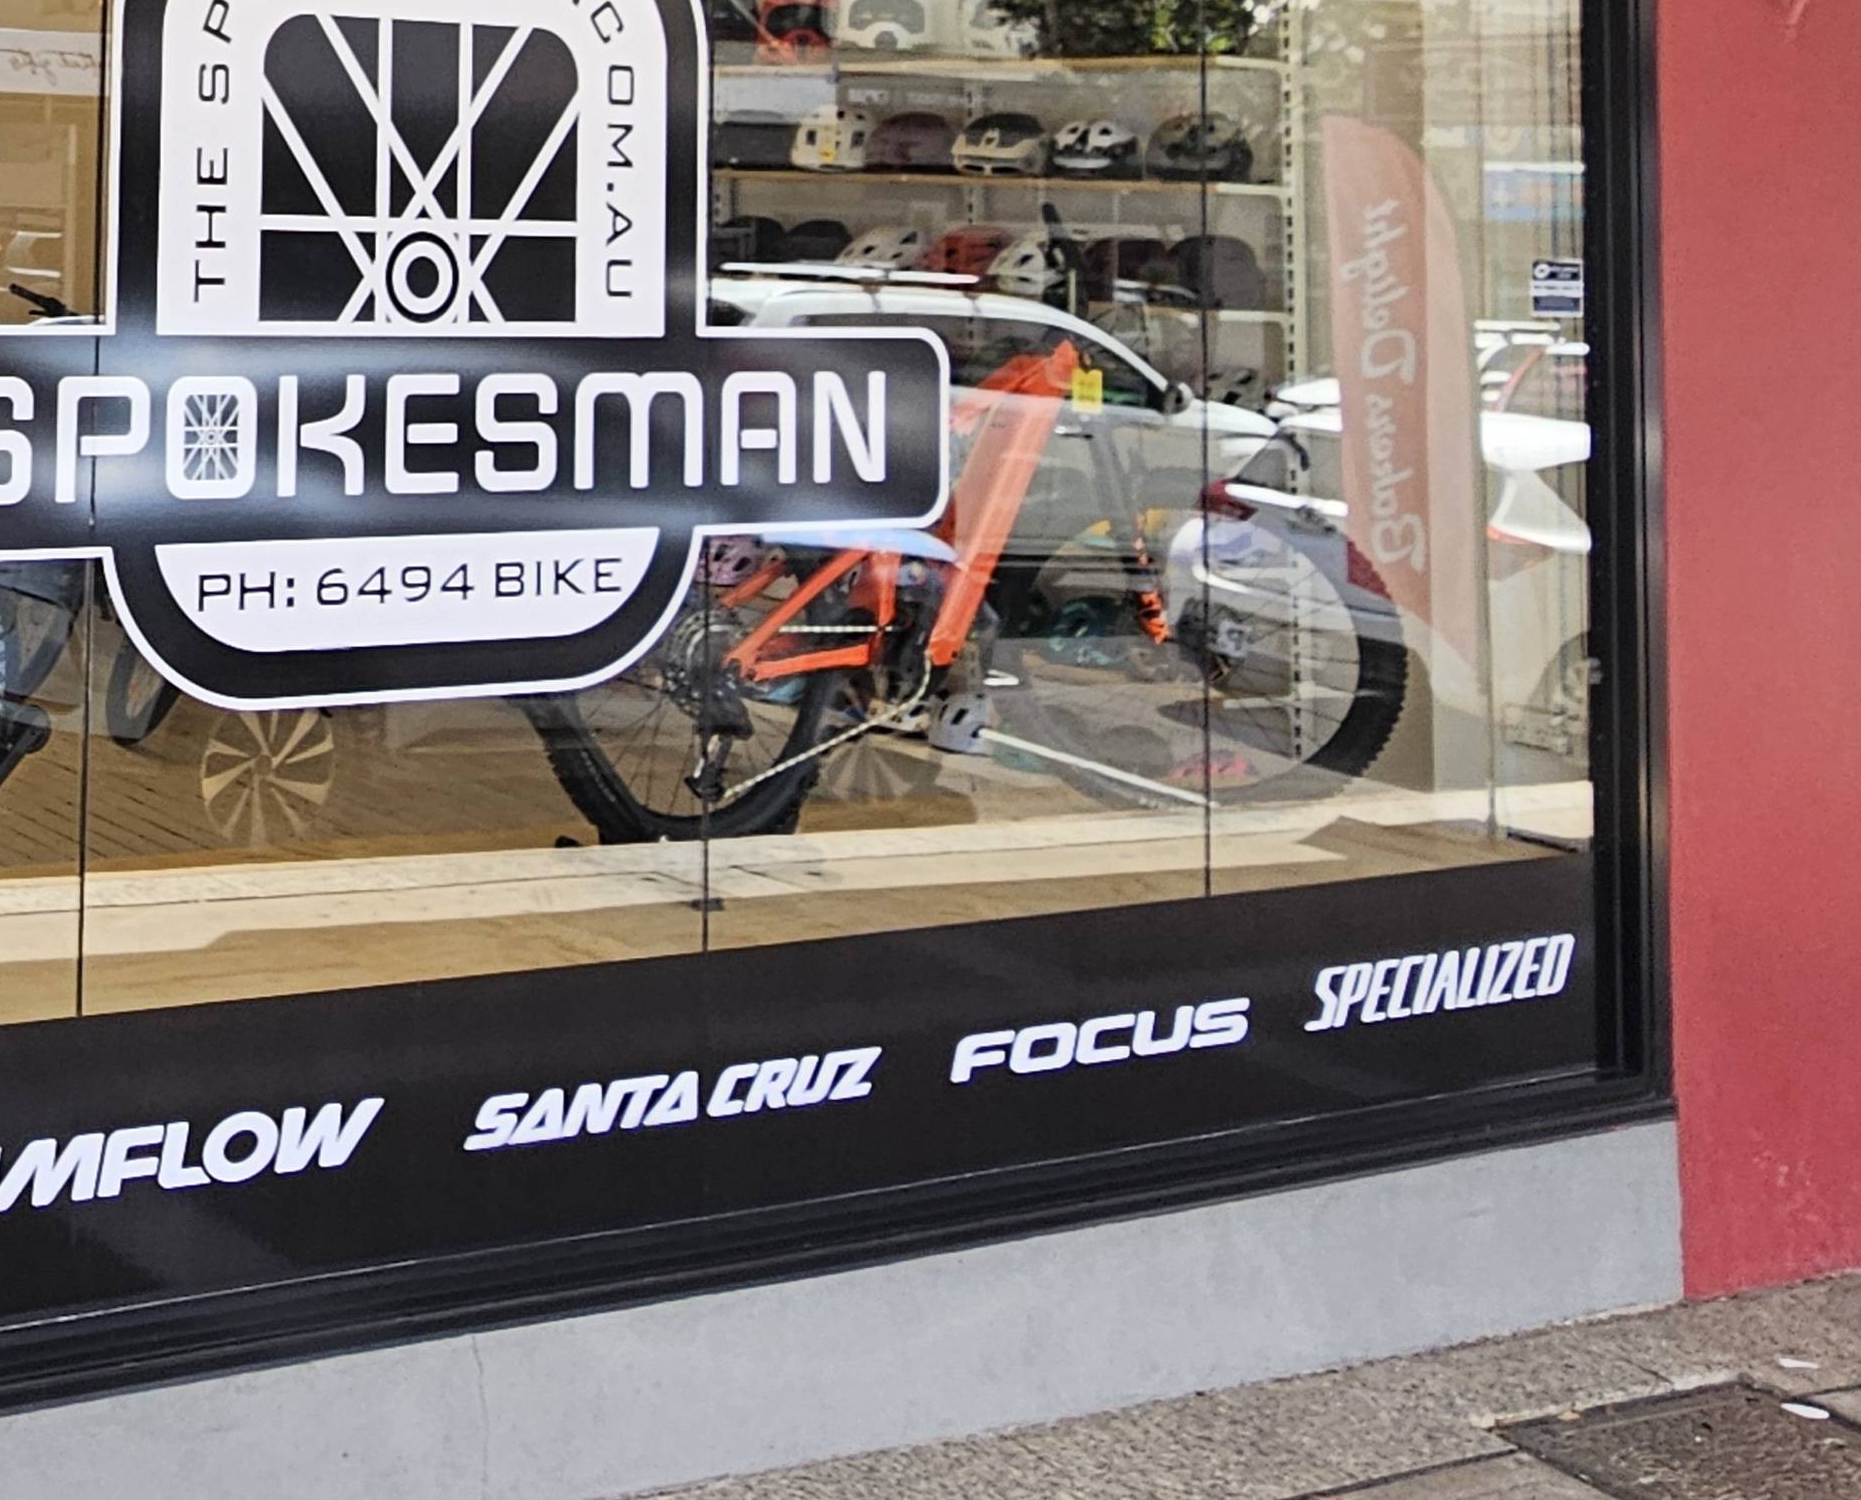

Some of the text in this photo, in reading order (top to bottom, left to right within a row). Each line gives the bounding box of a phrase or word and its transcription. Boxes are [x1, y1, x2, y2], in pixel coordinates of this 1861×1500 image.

[193, 145, 229, 303] THE
[197, 556, 624, 612] PH: 6494 BIKE
[1303, 933, 1576, 1034] SPECIALIZED
[949, 997, 1251, 1086] FOCUS
[463, 1044, 884, 1152] SANTA CRUZ
